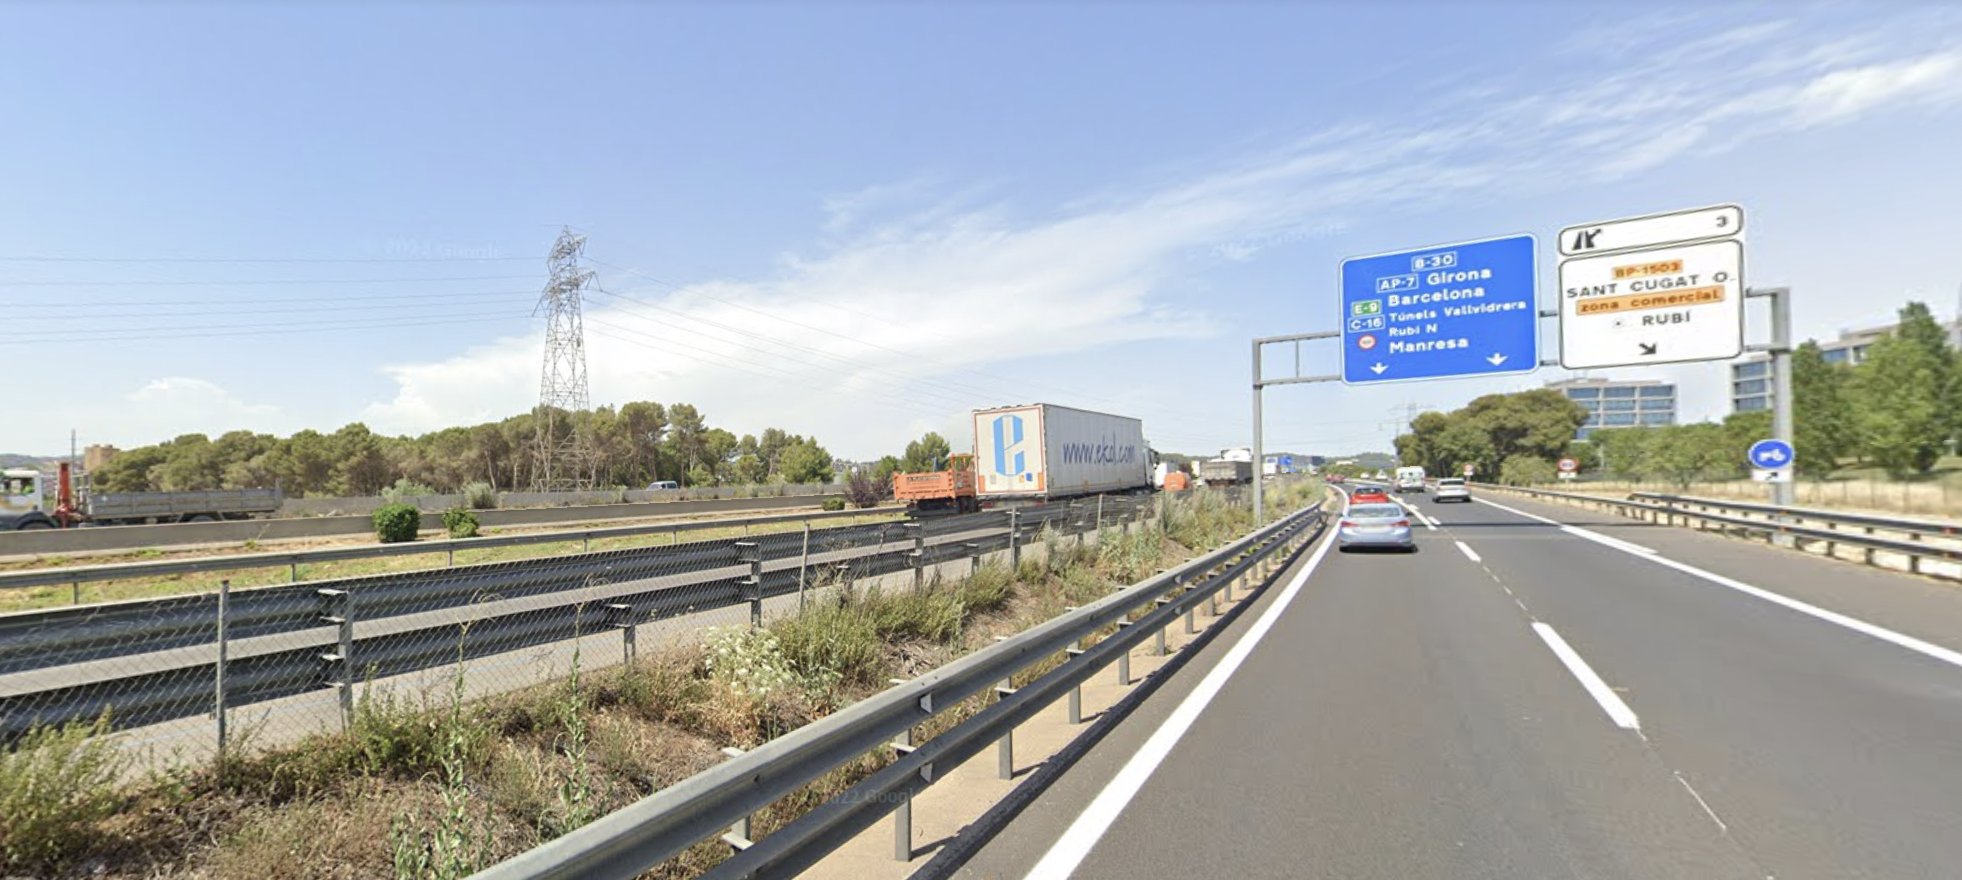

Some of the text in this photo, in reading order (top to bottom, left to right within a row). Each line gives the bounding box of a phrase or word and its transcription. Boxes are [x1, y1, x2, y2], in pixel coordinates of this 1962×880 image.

[1715, 215, 1728, 228] 3
[1414, 255, 1453, 269] B-30
[1615, 261, 1680, 278] BP-1503
[1380, 268, 1492, 290] AP-7 Girona
[1567, 283, 1618, 298] SANT
[1630, 274, 1699, 292] CUGAT
[1353, 287, 1485, 314] E-9 Barcelona
[1580, 290, 1719, 313] zona comercial
[1350, 318, 1383, 330] C-16
[1444, 300, 1527, 317] Vallvidrera
[1425, 323, 1438, 333] N
[1389, 337, 1469, 353] Manresa
